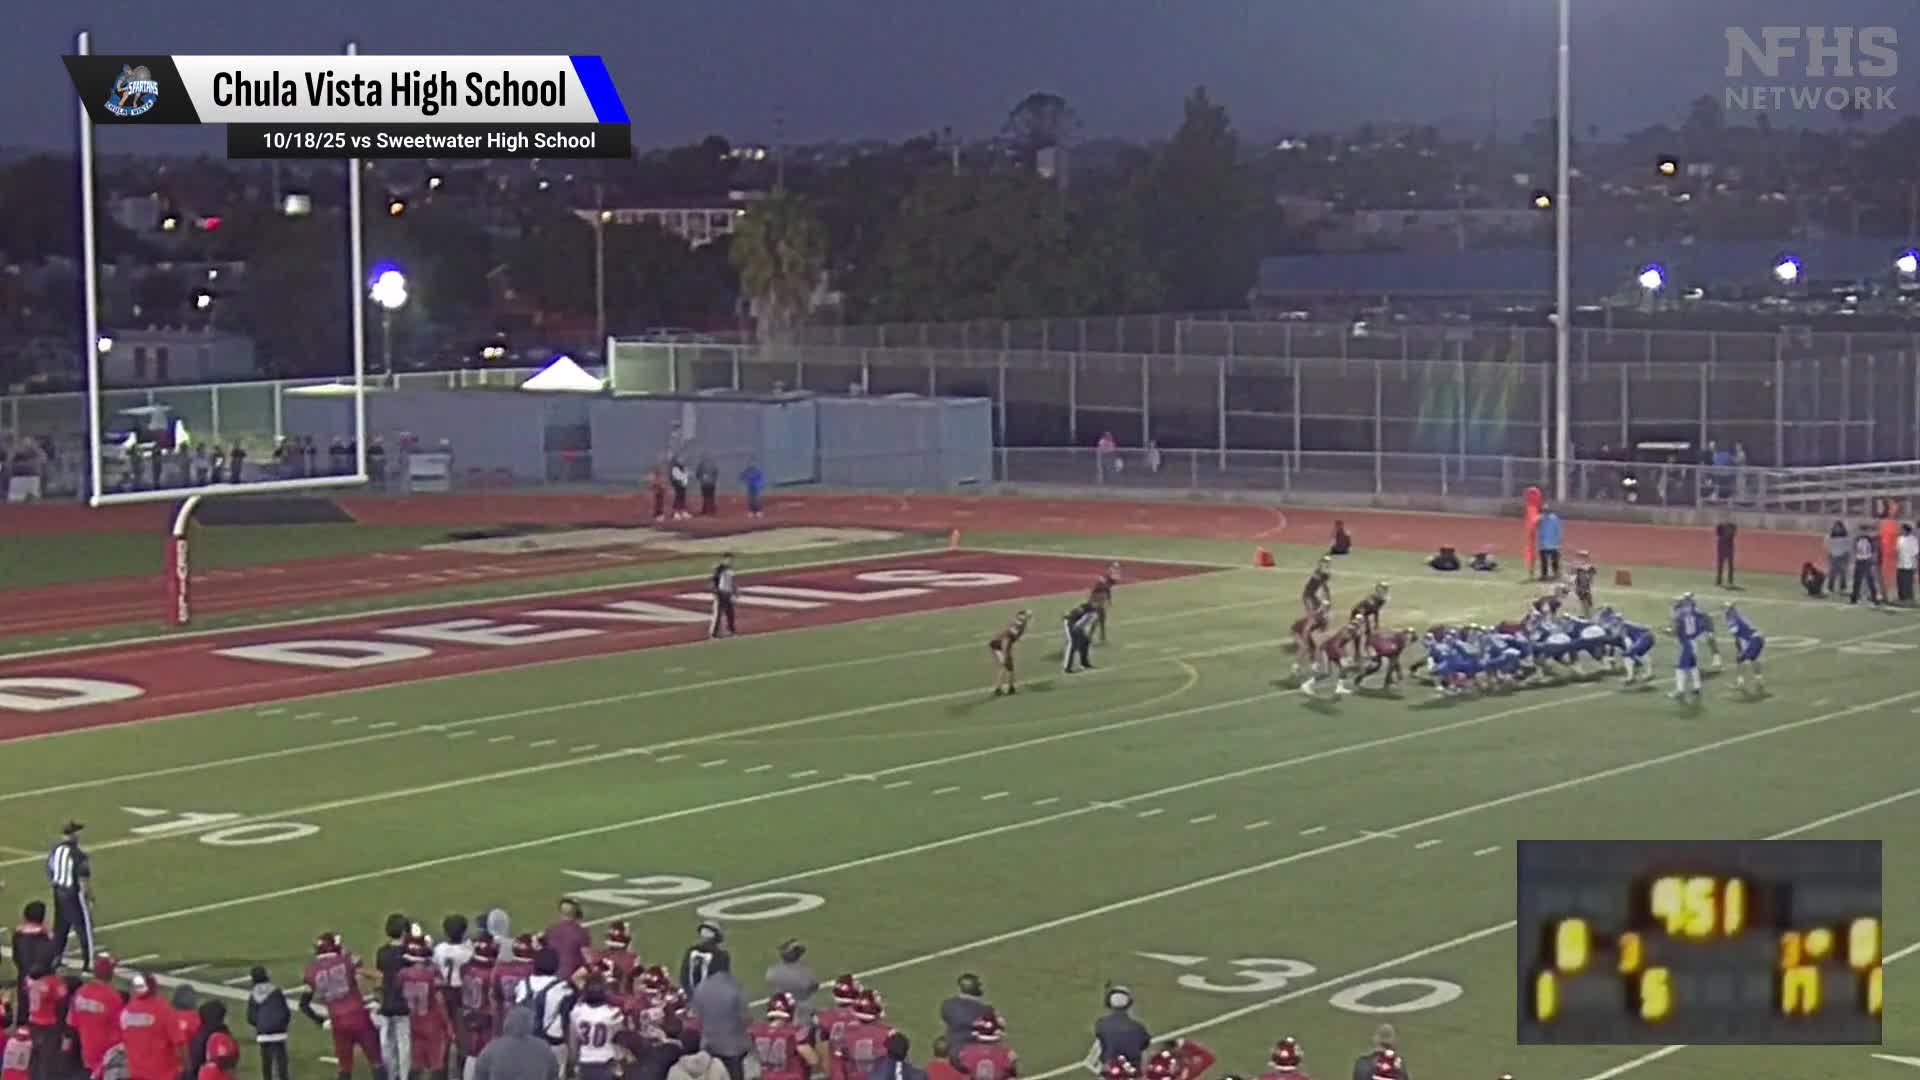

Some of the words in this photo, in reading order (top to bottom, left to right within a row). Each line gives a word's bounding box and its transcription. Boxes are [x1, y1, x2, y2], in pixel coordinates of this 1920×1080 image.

[212, 568, 1021, 668] DEVILS
[562, 875, 825, 920] 20
[1177, 958, 1463, 1013] 30
[578, 1021, 608, 1048] 30
